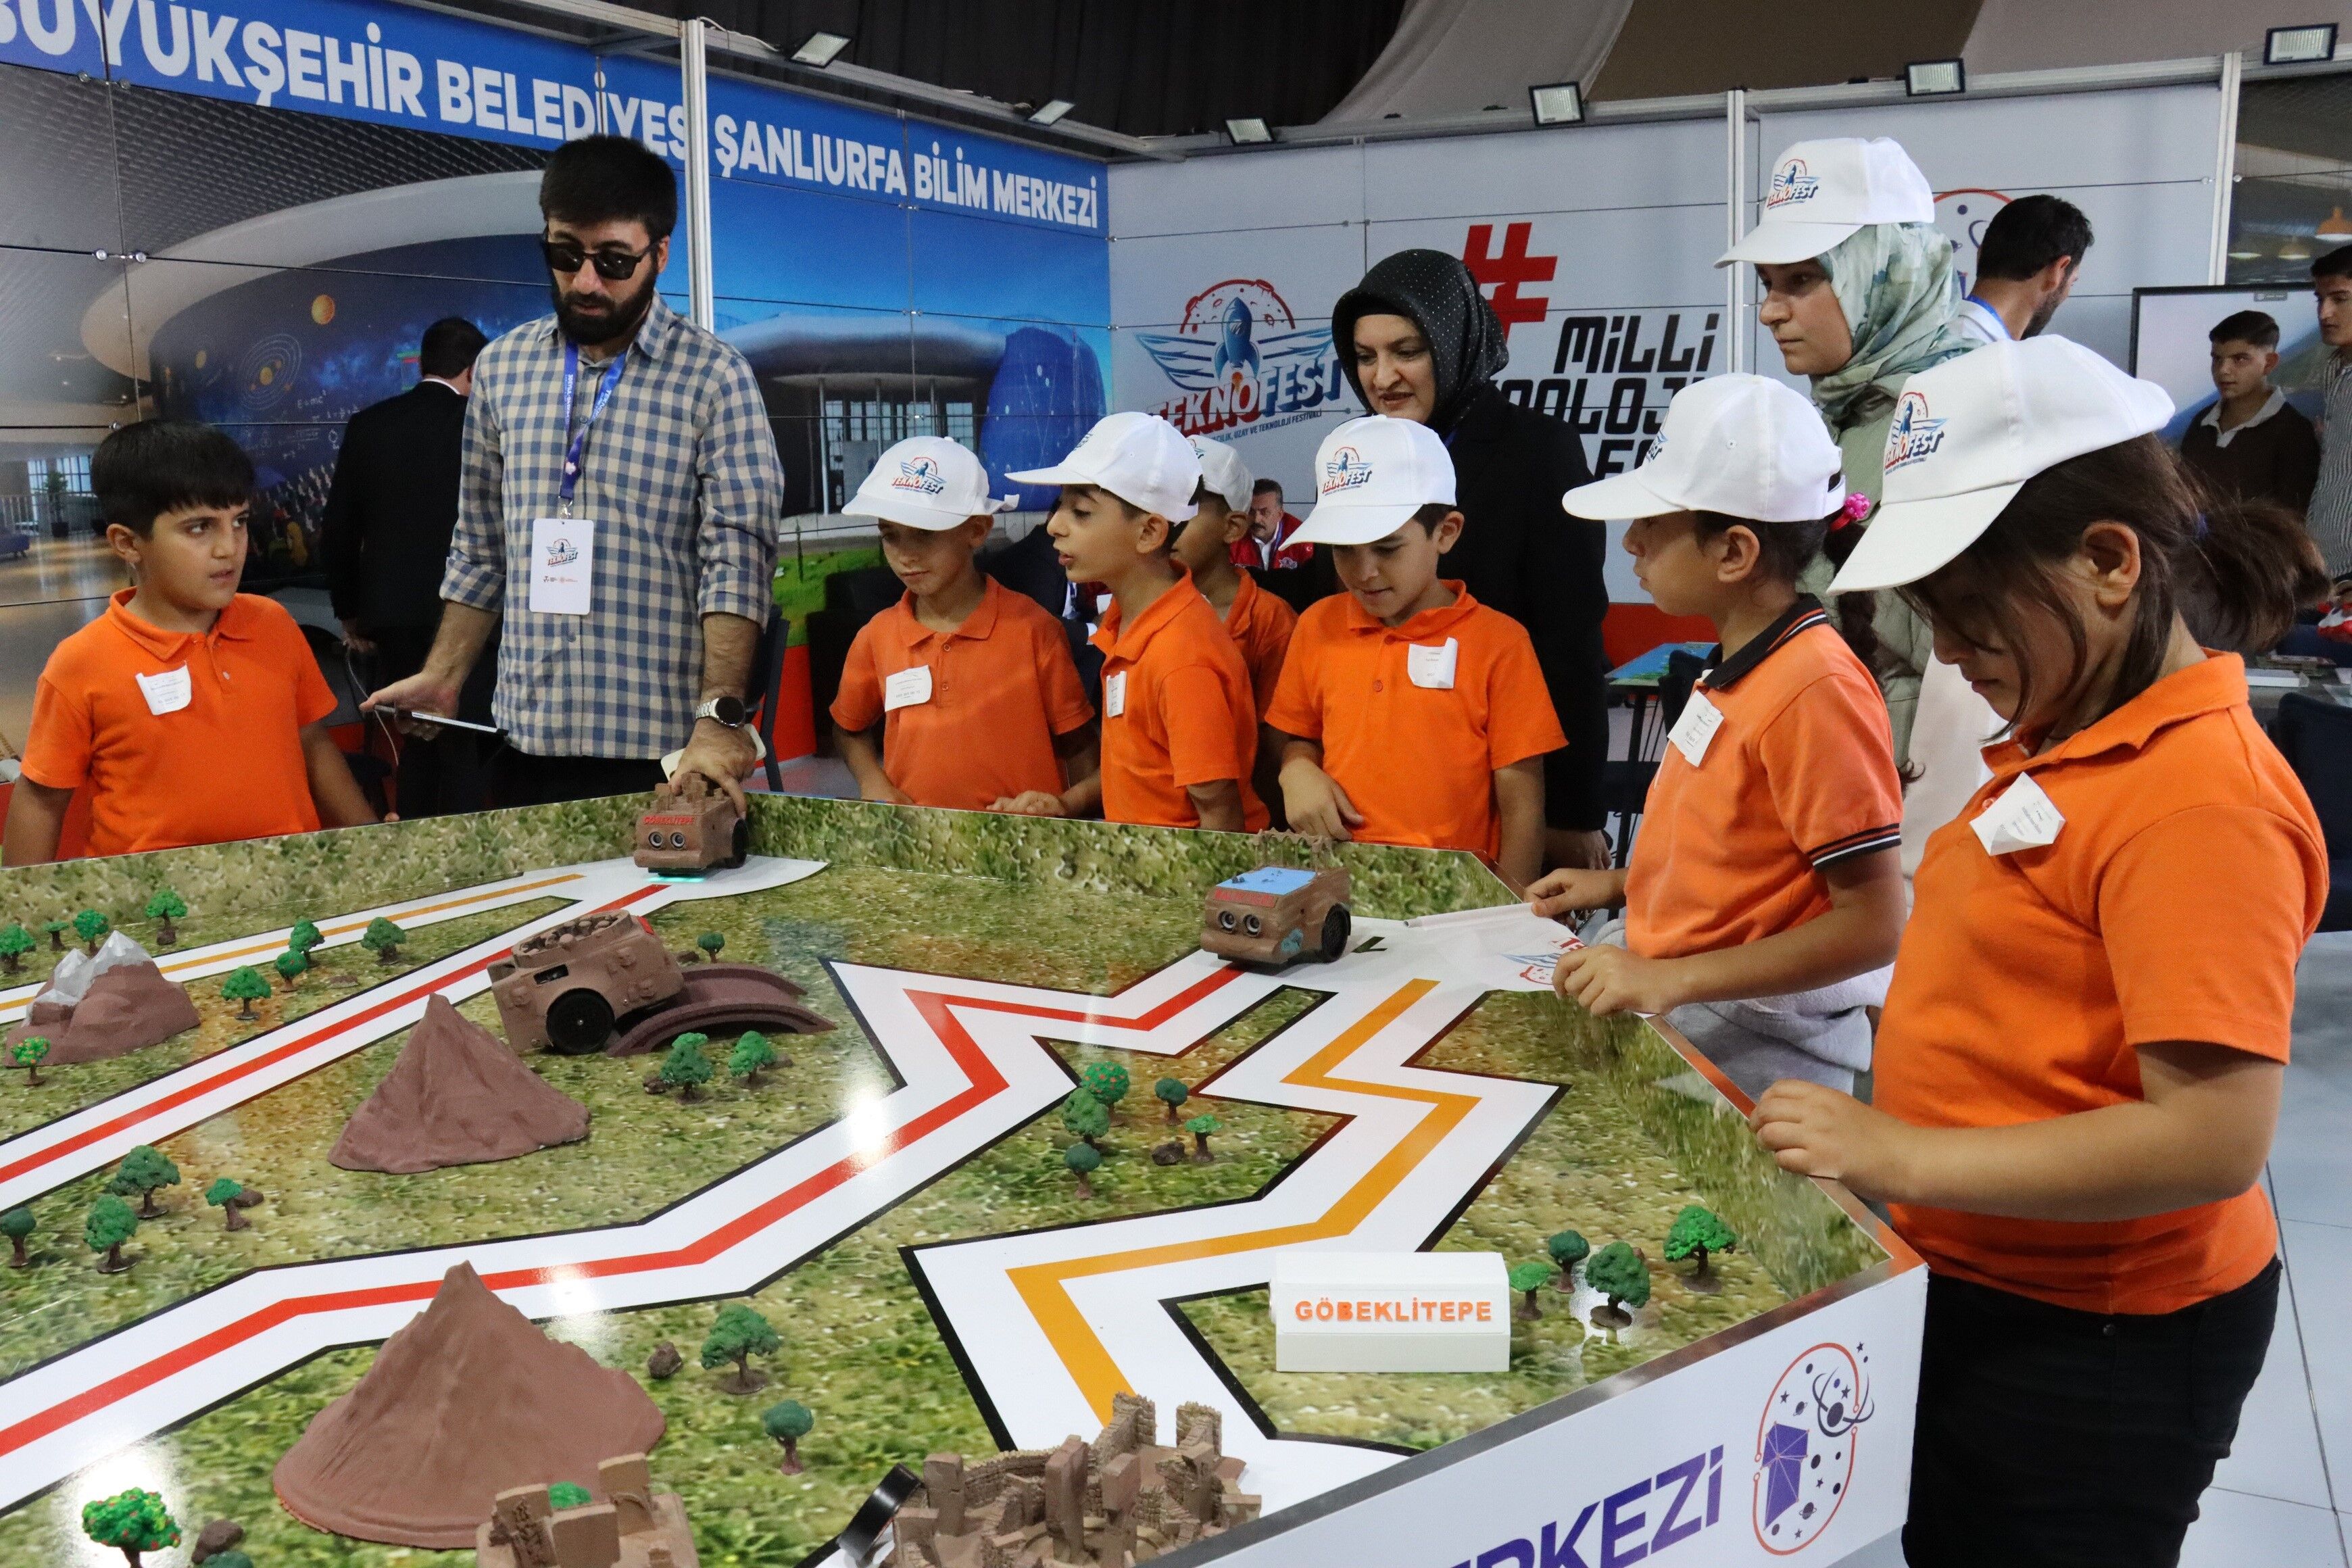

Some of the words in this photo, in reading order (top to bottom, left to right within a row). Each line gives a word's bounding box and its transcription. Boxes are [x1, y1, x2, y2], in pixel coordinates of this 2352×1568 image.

[436, 59, 686, 160] BELEDİYES
[715, 114, 907, 197] ŞANLIURFA
[914, 141, 987, 210] BİLİM
[994, 171, 1098, 228] MERKEZİ
[1250, 425, 1258, 435] VE
[1258, 416, 1291, 433] TEKNOLOJİ
[1294, 1296, 1492, 1323] GÖBEKLİTEPE
[1446, 1444, 1724, 1568] KEZİ
